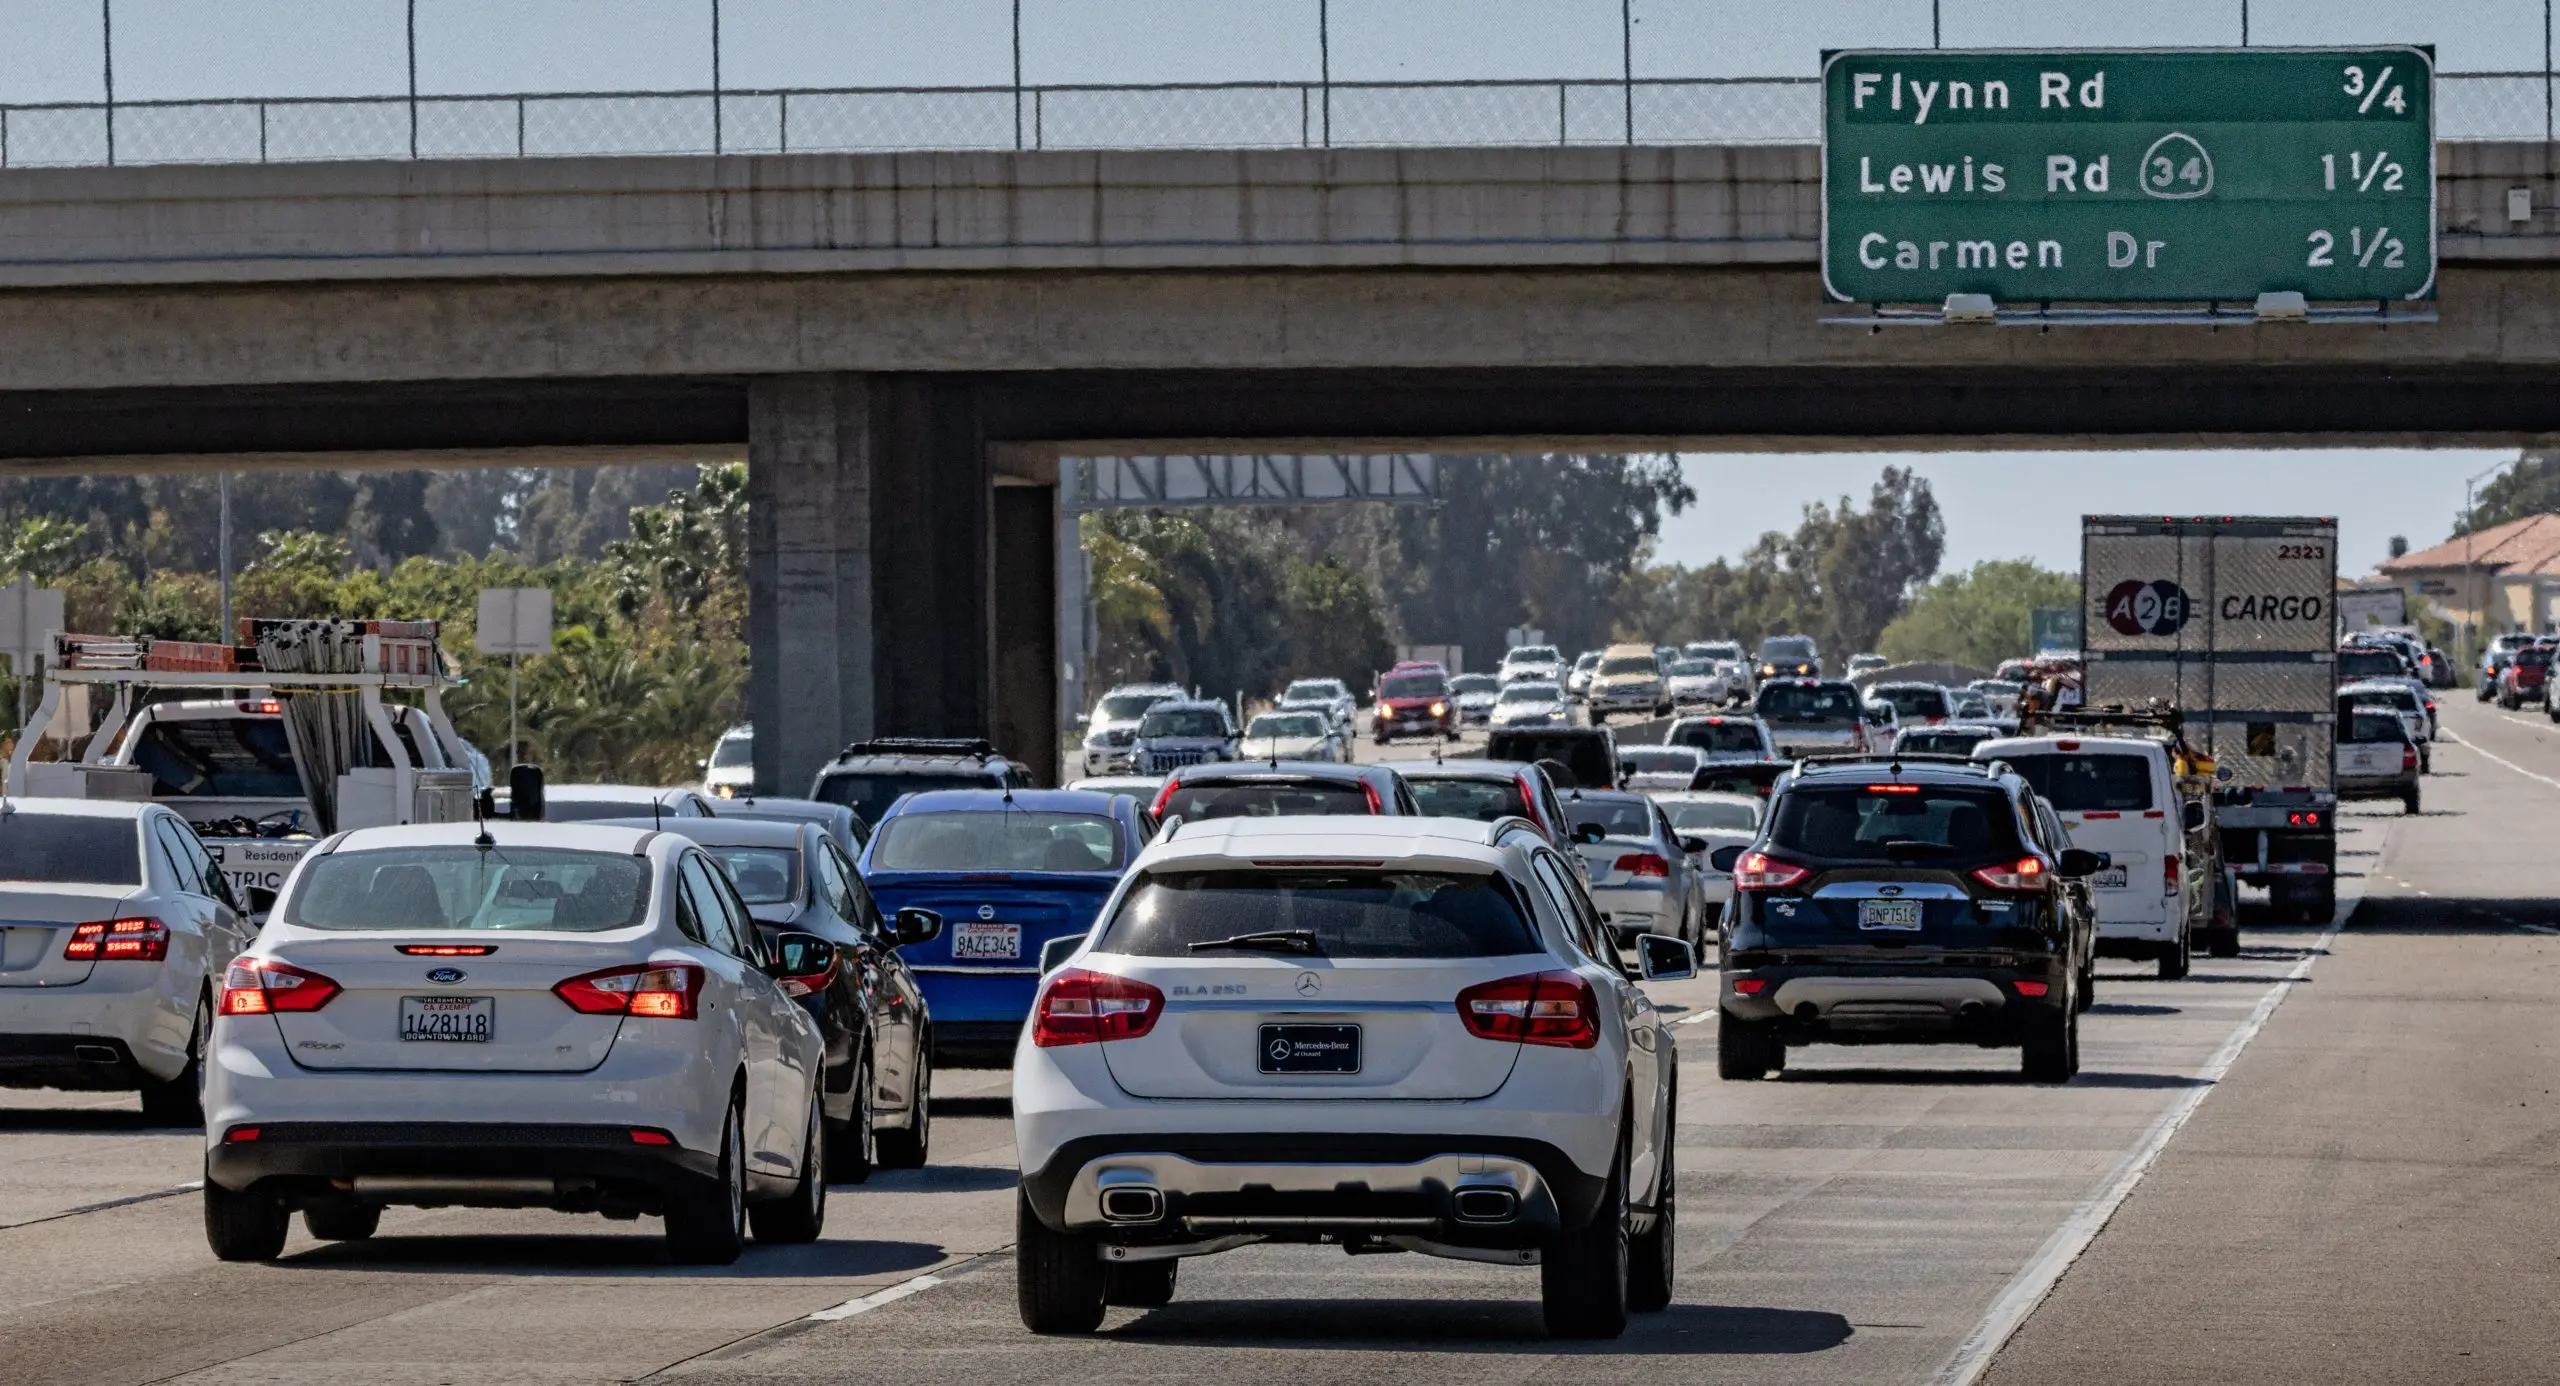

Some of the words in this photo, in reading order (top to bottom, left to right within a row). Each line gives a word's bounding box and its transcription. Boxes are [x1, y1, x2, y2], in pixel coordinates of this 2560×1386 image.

[1853, 72, 2010, 124] Flynn
[2040, 71, 2105, 109] Rd
[1859, 156, 2006, 193] Lewis
[2046, 154, 2110, 193] Rd
[2151, 155, 2202, 187] 34
[1859, 232, 2063, 269] Carmen
[2107, 231, 2166, 269] Dr
[2278, 545, 2325, 560] 2323
[2221, 595, 2322, 621] CARGO
[957, 936, 1016, 953] 8AZE345
[433, 969, 457, 981] Ford
[1172, 984, 1208, 997] GLA
[1211, 984, 1247, 996] 250
[407, 1013, 487, 1034] 1428118
[406, 1033, 459, 1041] DOWNTOWN
[461, 1033, 485, 1041] FORD
[1294, 1041, 1350, 1050] Mercedes-Benz
